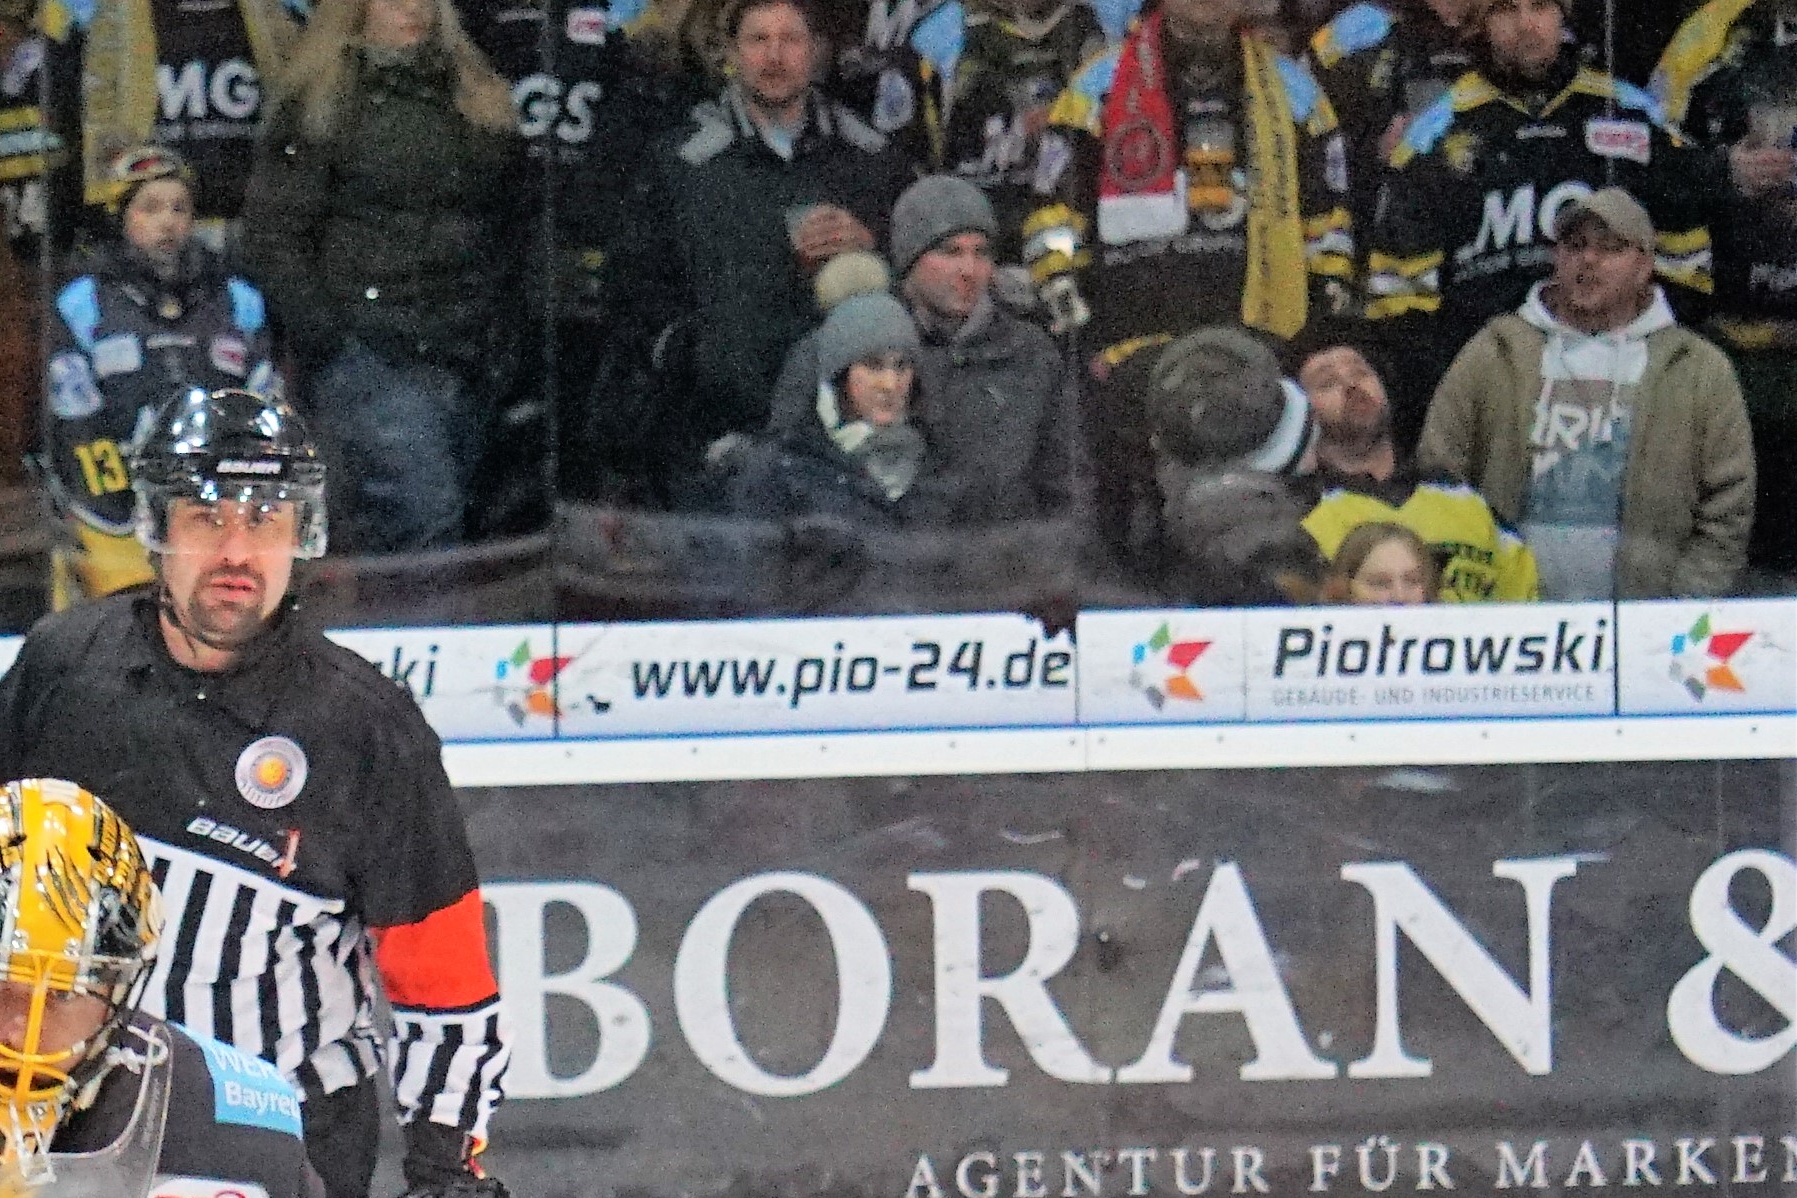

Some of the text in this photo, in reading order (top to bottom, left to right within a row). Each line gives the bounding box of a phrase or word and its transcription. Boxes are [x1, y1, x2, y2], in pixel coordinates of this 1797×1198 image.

[156, 59, 261, 119] MG
[511, 74, 602, 143] GS
[631, 636, 1072, 708] www.pio-24.de
[1273, 618, 1608, 679] Piotrowski
[487, 858, 1580, 1100] BORAN
[223, 1080, 301, 1119] Bayreu
[1309, 1132, 1455, 1194] FÜR
